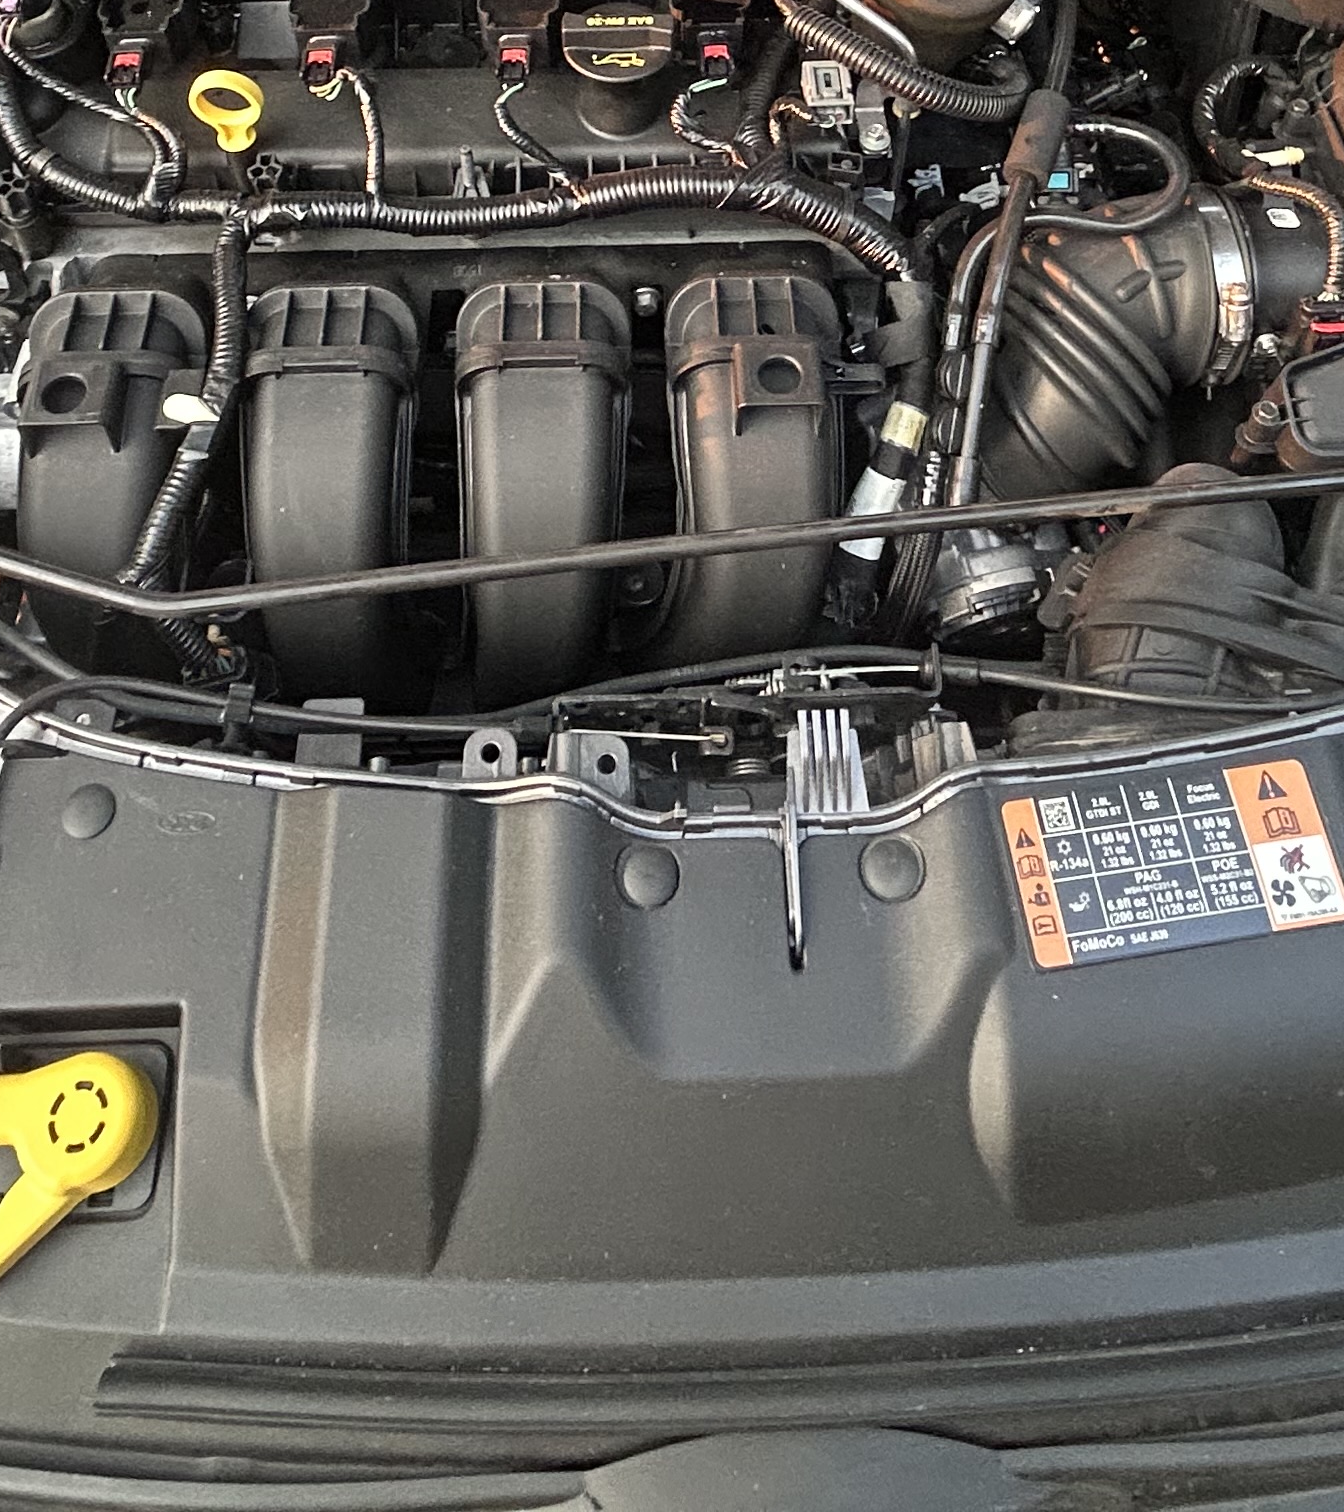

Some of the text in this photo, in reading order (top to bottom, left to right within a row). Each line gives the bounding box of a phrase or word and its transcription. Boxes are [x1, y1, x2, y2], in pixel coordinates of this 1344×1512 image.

[1162, 822, 1178, 837] kg
[1216, 816, 1232, 830] kg
[1115, 830, 1131, 844] kg
[1049, 856, 1090, 872] R-134a
[1211, 857, 1240, 872] POE
[1134, 869, 1162, 884] PAG
[1156, 888, 1200, 903] 4.0 fl oz
[1210, 880, 1255, 896] 5.2 fl oz
[1133, 896, 1149, 908] oz
[1215, 890, 1259, 911] (155 cc)
[1160, 899, 1204, 919] (120 cc)
[1109, 907, 1154, 927] (200 cc)
[1071, 934, 1125, 953] FoMoCo
[1130, 931, 1149, 944] SAE
